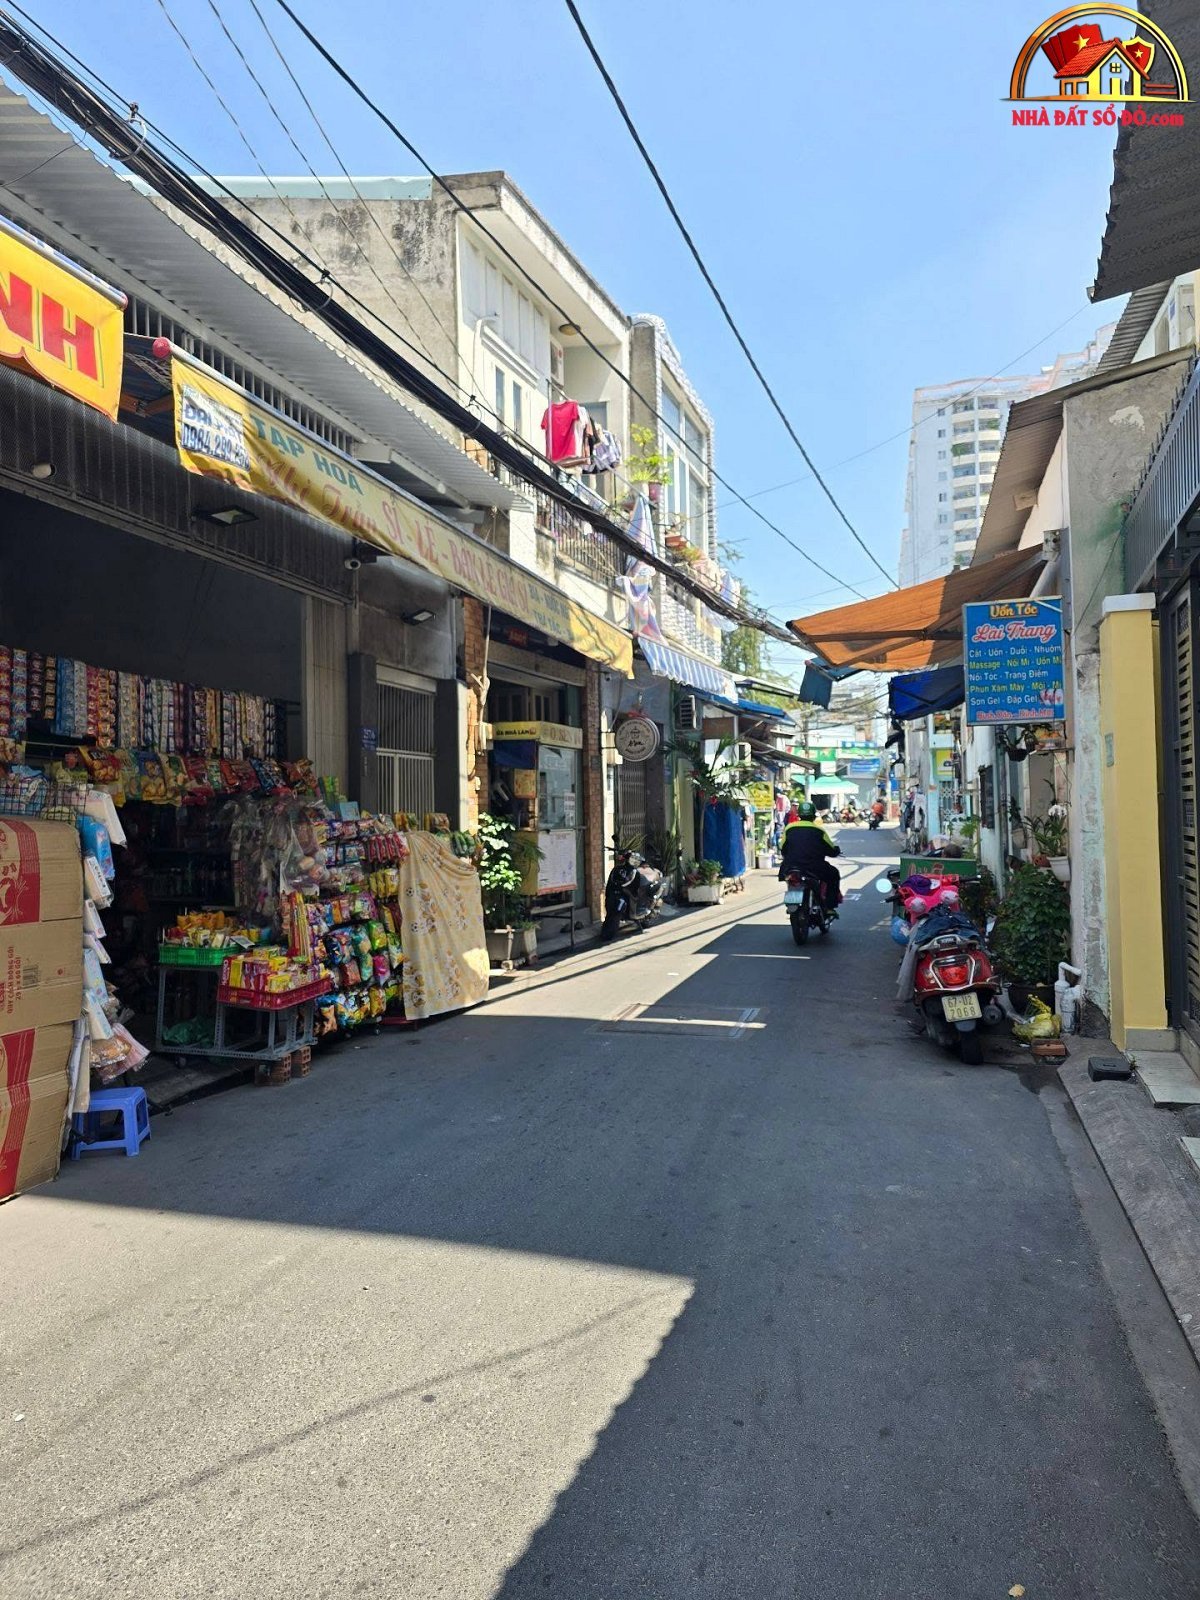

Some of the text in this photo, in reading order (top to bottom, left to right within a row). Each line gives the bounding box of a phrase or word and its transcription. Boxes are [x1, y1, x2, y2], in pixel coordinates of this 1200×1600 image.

[250, 414, 305, 459] TẠP
[312, 450, 364, 496] HOÁ
[990, 603, 1037, 617] Uốn Tóc
[1006, 621, 1056, 643] Trang
[969, 661, 1000, 670] Massage
[1004, 671, 1026, 680] Trang
[988, 696, 1000, 705] Gel
[1024, 694, 1038, 703] Gel
